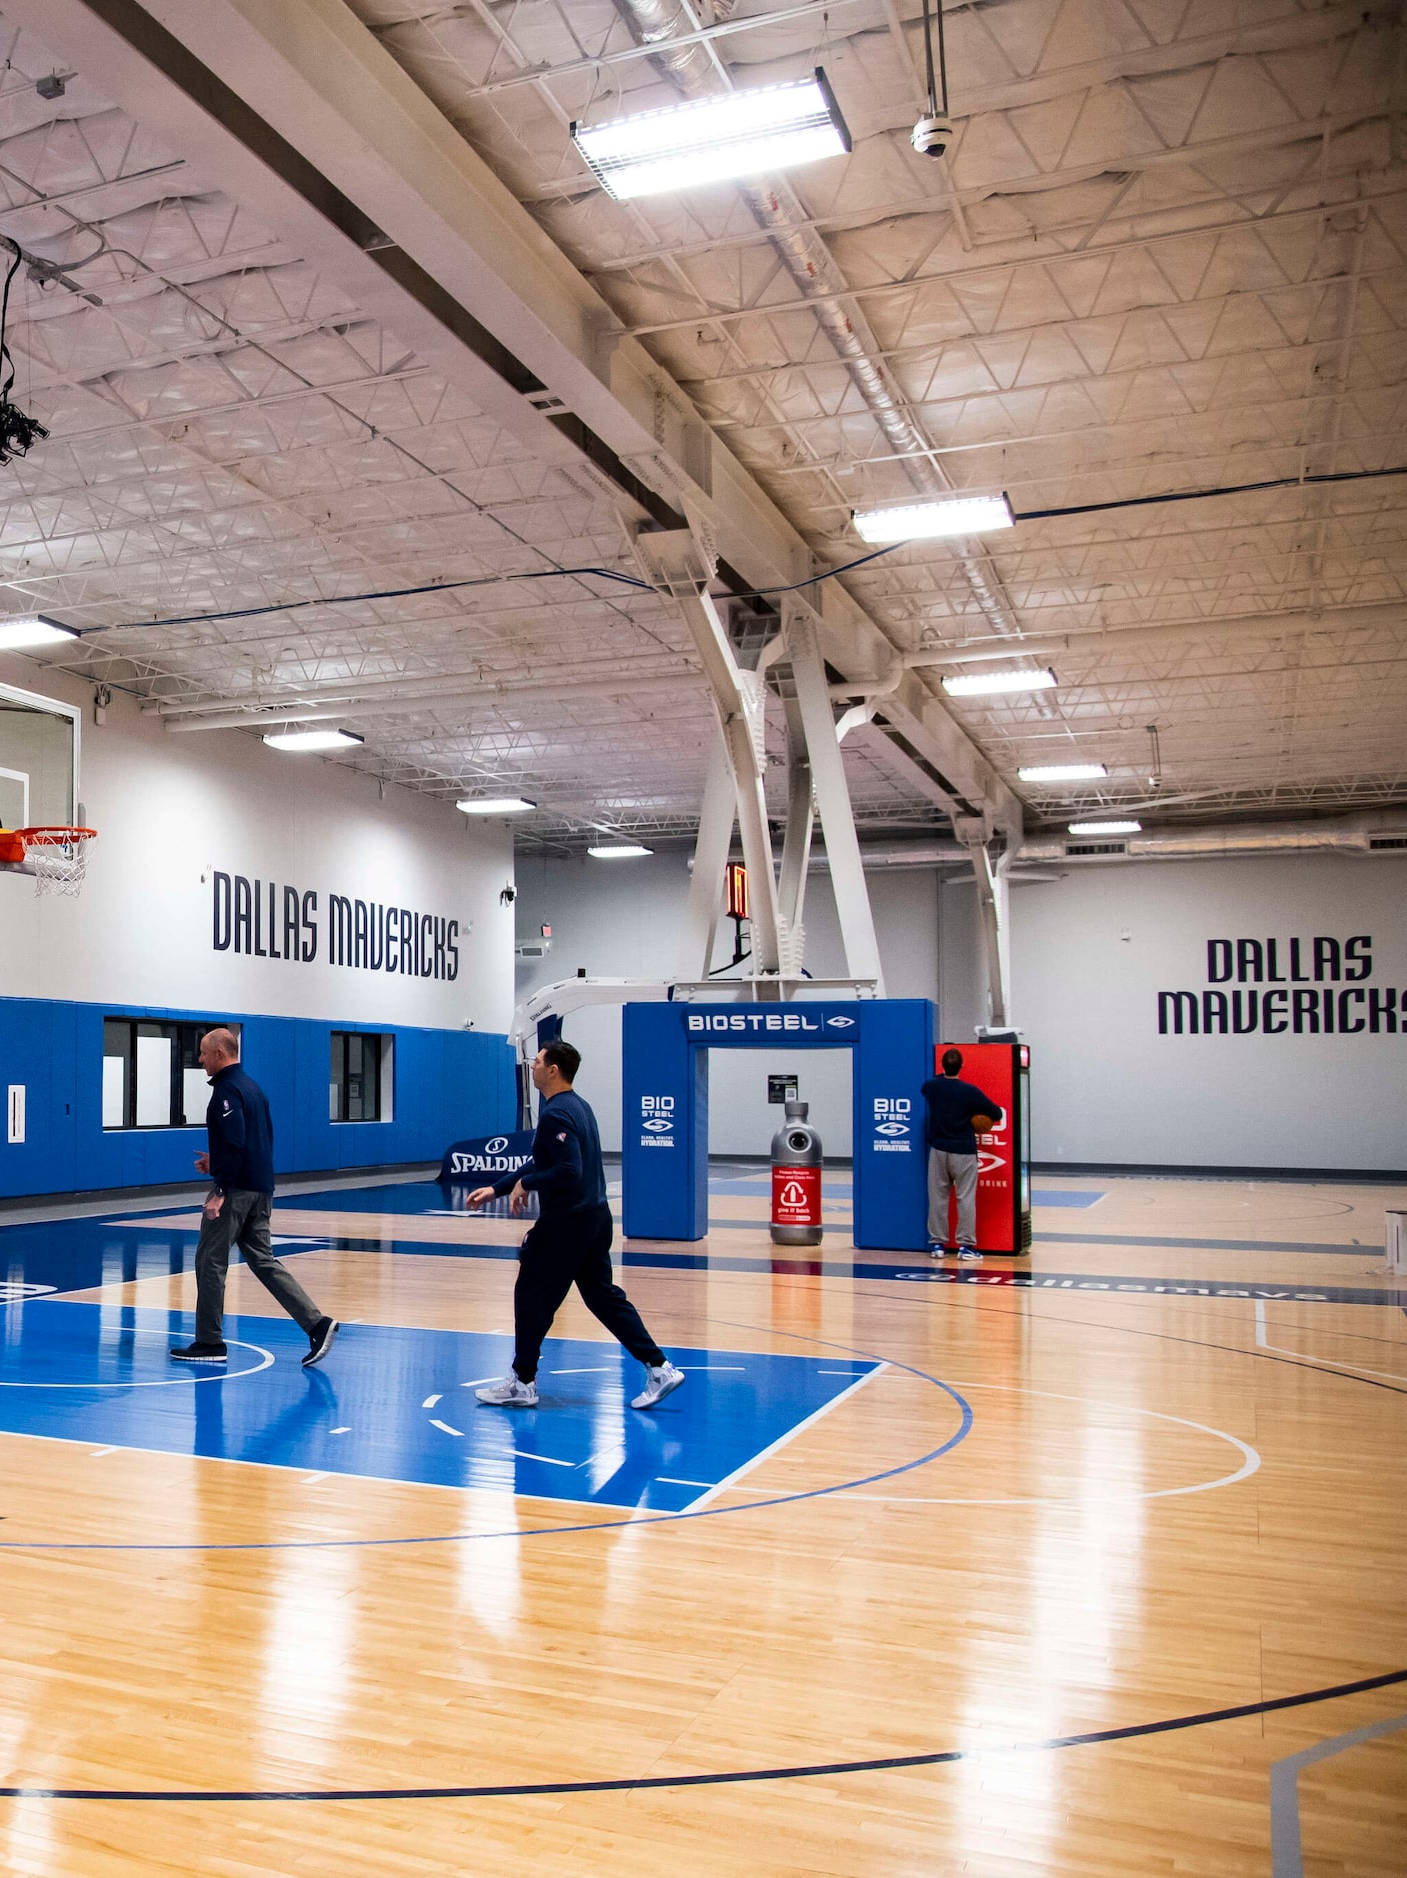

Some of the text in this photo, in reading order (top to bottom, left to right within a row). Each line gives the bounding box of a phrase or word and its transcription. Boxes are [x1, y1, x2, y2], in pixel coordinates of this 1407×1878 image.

[213, 870, 459, 982] DALLAS MAVERICKS
[1207, 935, 1372, 982] DALLAS
[1157, 987, 1407, 1034] MAVERICK
[688, 1015, 819, 1031] BIOSTEEL
[641, 1096, 675, 1110] BIO
[874, 1098, 911, 1113] BIO
[451, 1152, 535, 1174] SPALDIN
[979, 1180, 1008, 1188] DRINK
